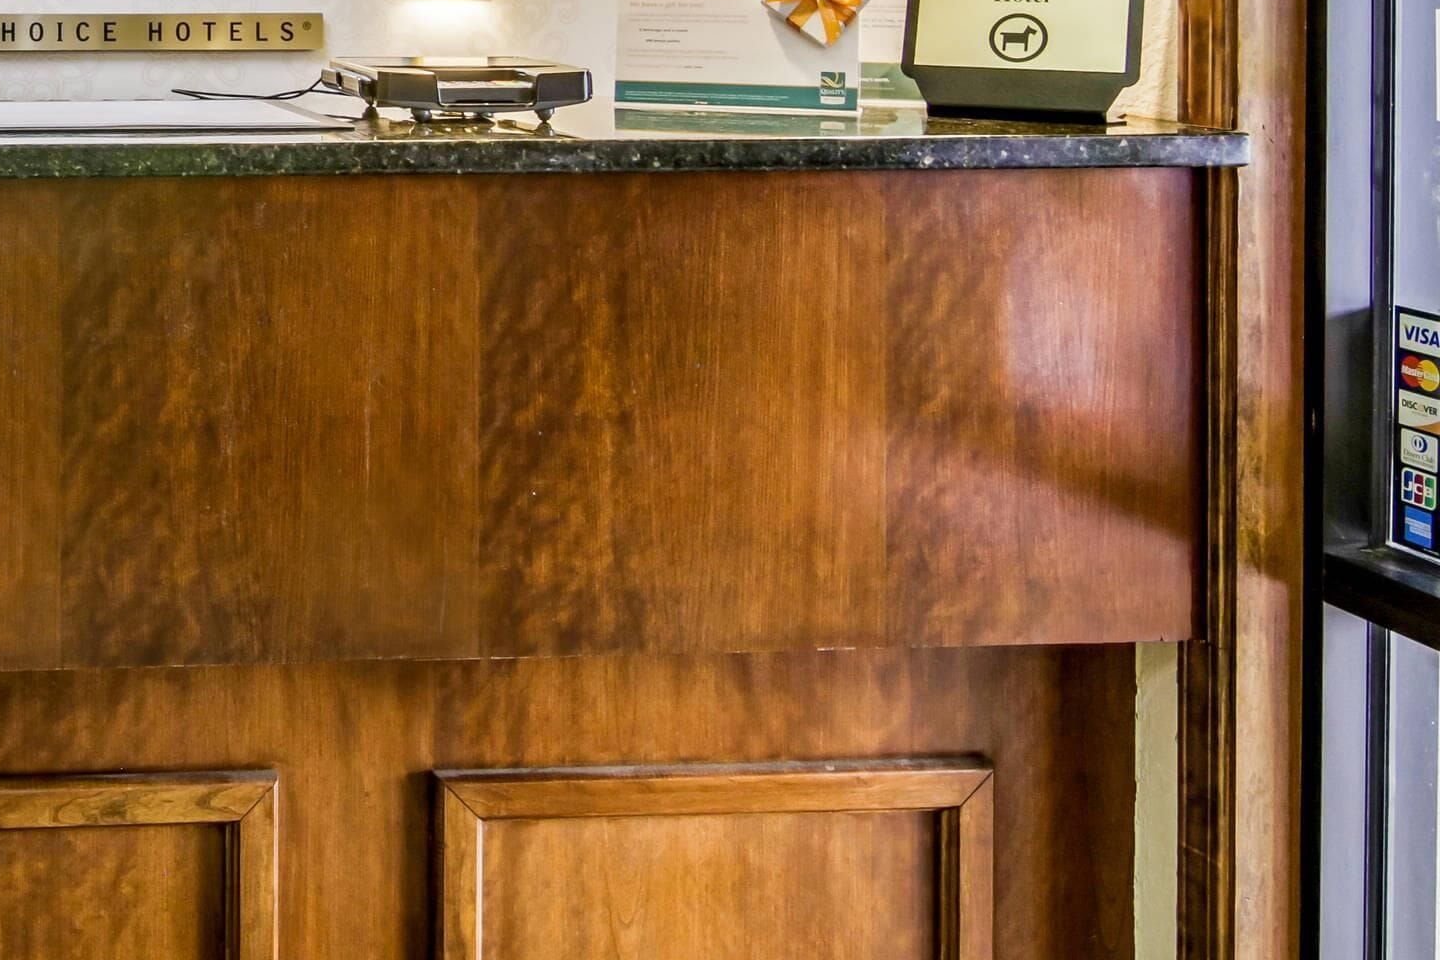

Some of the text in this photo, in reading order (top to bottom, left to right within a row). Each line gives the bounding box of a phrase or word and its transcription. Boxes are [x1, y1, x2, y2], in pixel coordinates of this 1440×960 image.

[1404, 325, 1440, 348] VISA
[1401, 398, 1438, 416] DISCOVER
[1403, 480, 1433, 499] JCB
